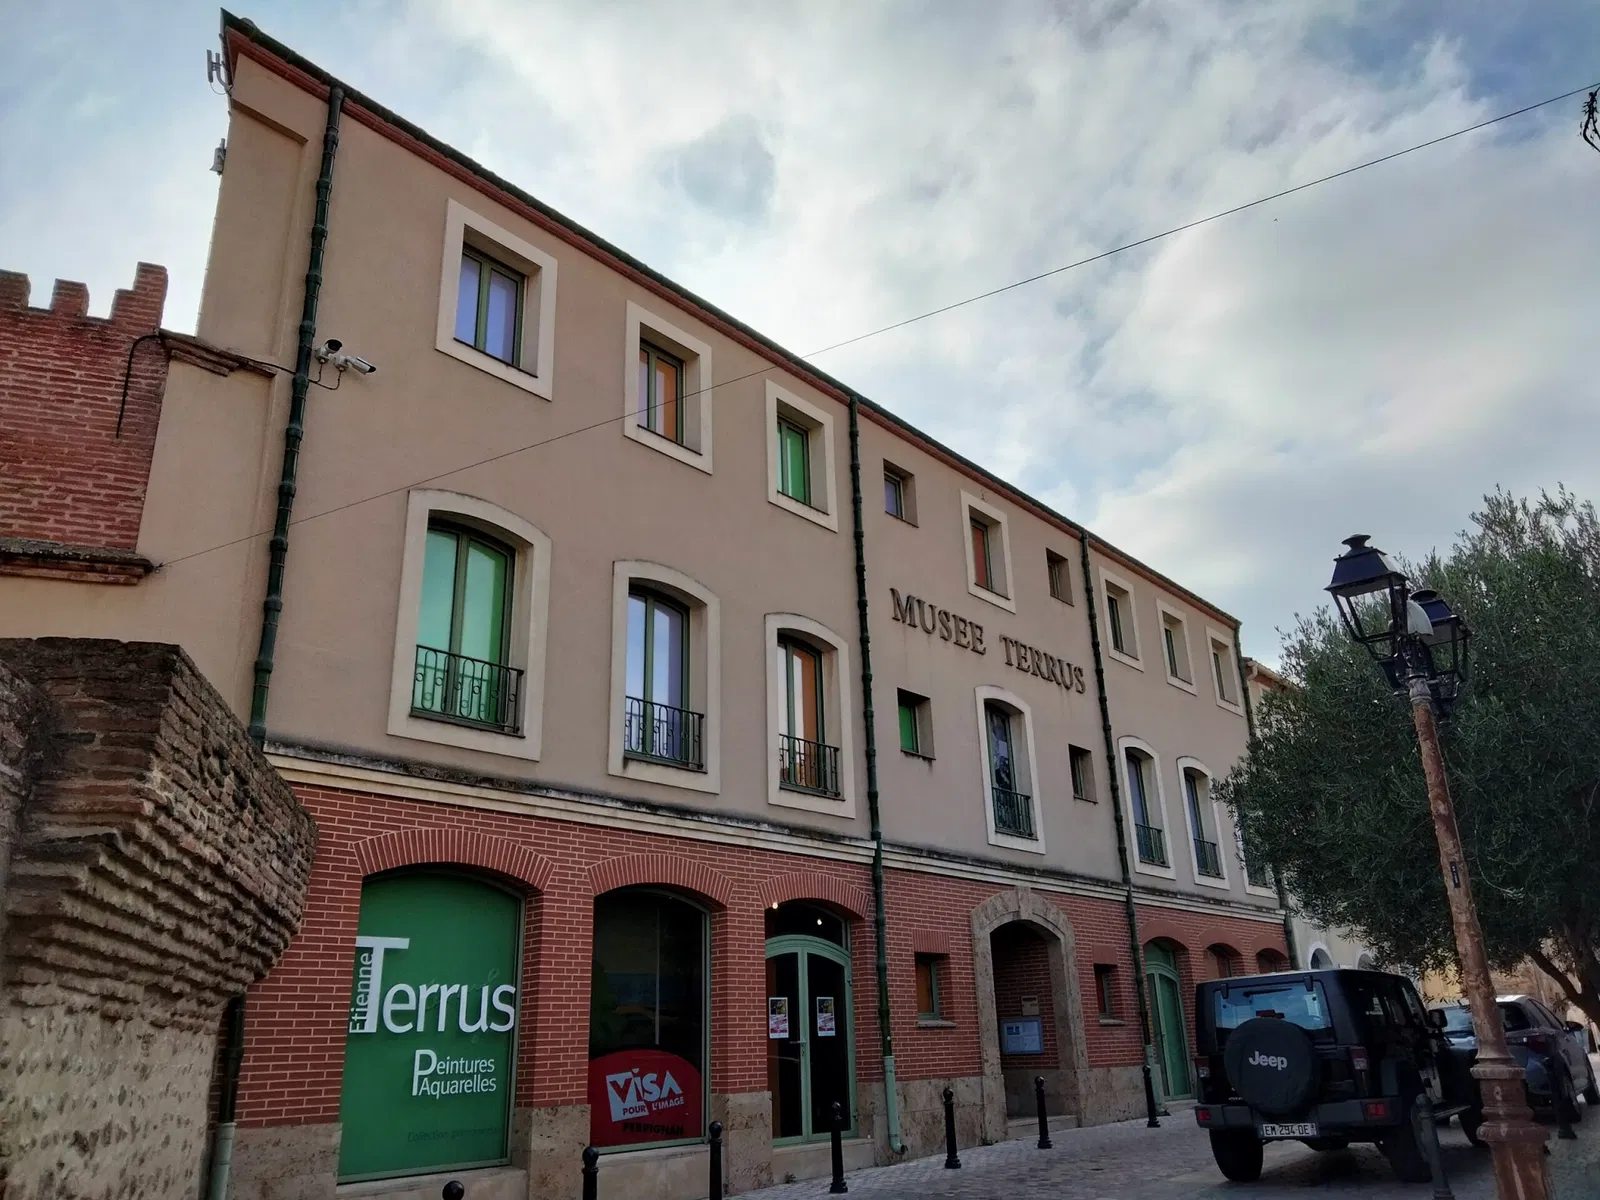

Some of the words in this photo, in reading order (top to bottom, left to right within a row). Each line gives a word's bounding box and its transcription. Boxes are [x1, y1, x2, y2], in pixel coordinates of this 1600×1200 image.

[889, 587, 986, 656] MUSEE
[999, 634, 1086, 694] TERRUS
[349, 953, 373, 1033] Etienne
[355, 936, 516, 1034] Terrus
[412, 1049, 495, 1096] Peintures
[1248, 1051, 1288, 1070] Jeep
[418, 1075, 497, 1100] Aquarelles
[623, 1105, 646, 1116] POUR
[652, 1096, 684, 1111] L'IMAGE
